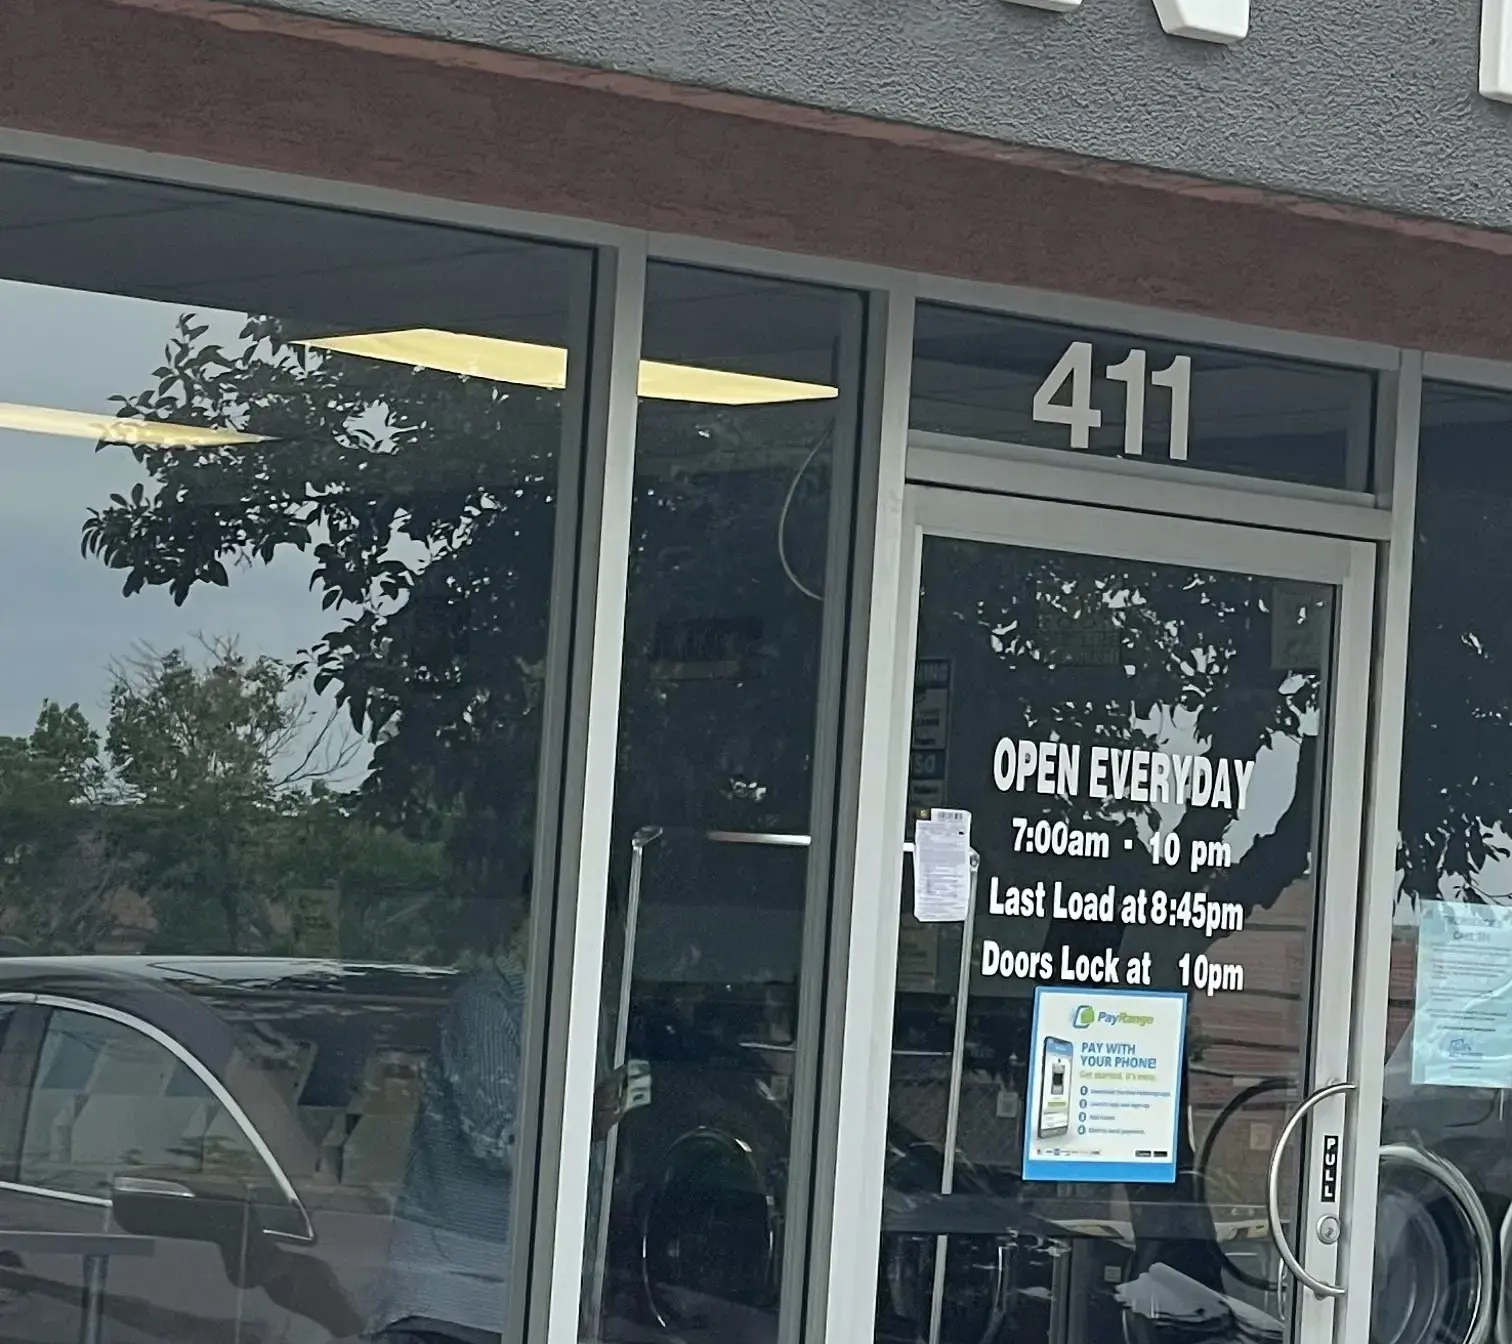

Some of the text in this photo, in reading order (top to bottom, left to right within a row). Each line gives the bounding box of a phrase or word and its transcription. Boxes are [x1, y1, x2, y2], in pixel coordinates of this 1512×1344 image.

[1033, 341, 1191, 460] 411
[993, 737, 1254, 809] OPEN EVERYDAY
[1012, 817, 1110, 858] 7:00am
[1150, 831, 1181, 866] 10
[1190, 840, 1231, 872] pm
[989, 876, 1244, 937] Last Load at 8:45pm
[982, 940, 1244, 996] Doors Lock at 10pm
[1080, 1055, 1111, 1067] YOUR
[1081, 1042, 1136, 1055] PAY WITH
[1325, 1138, 1336, 1197] PULL
